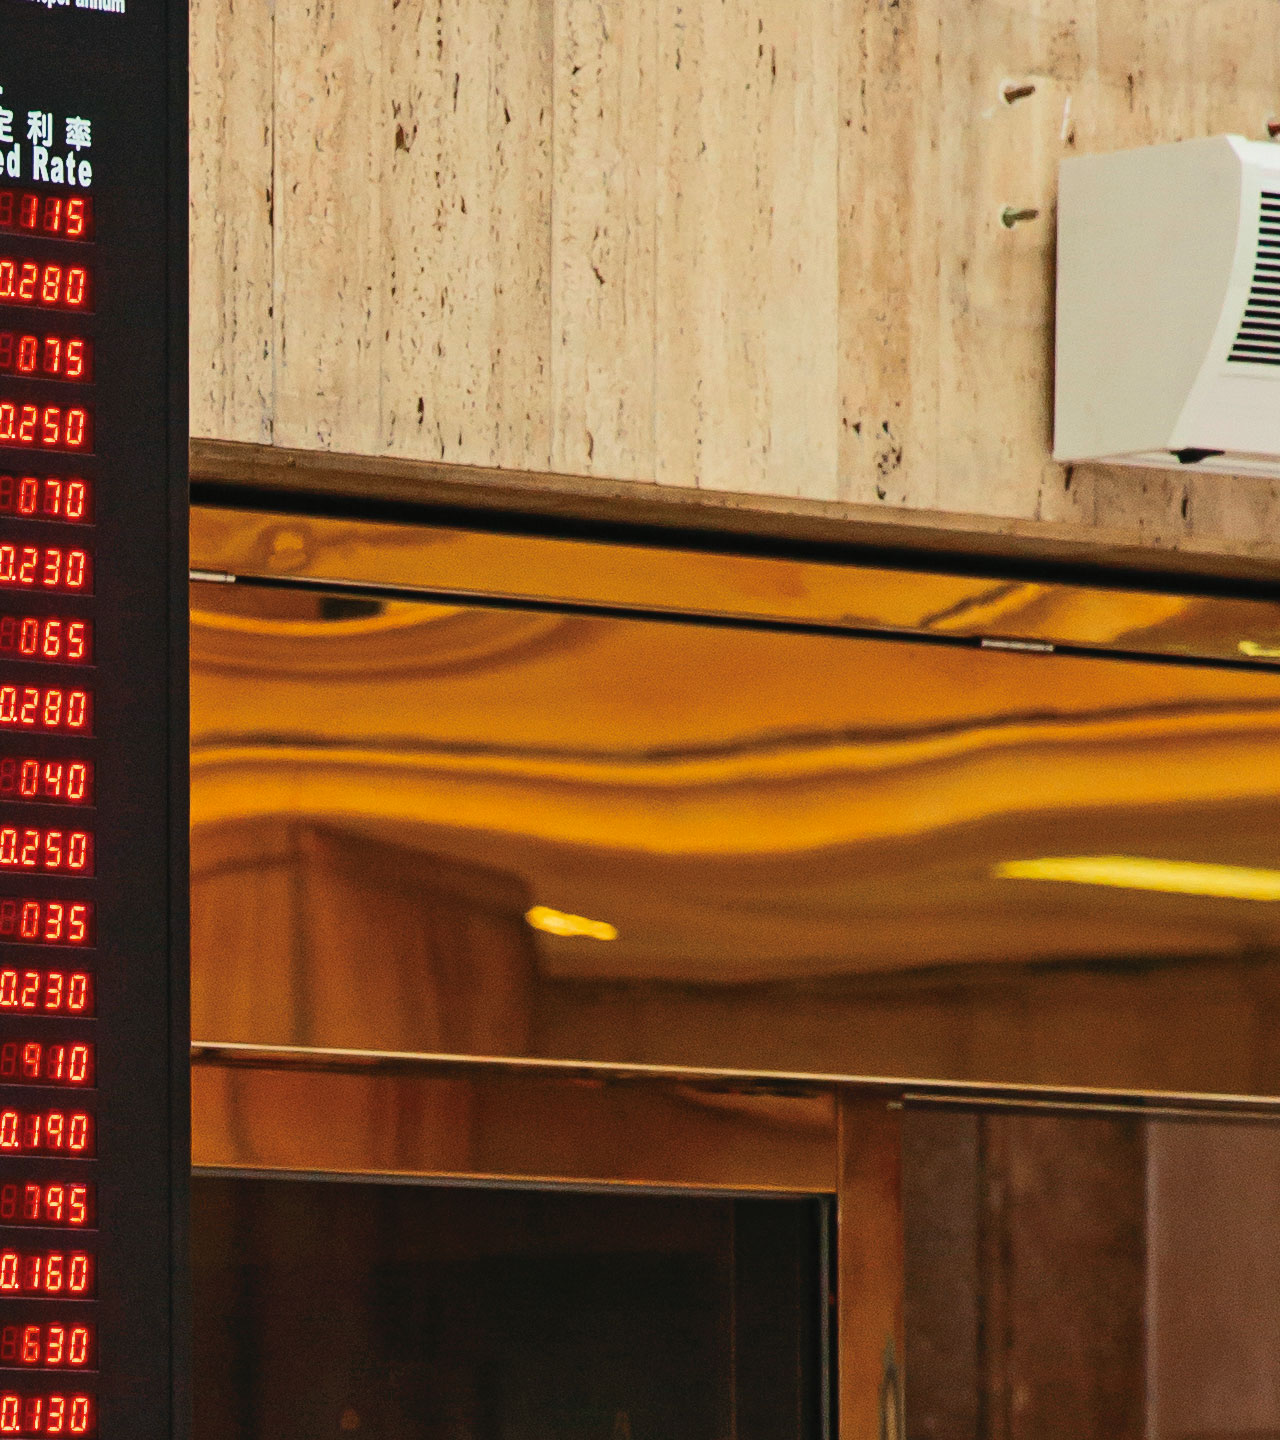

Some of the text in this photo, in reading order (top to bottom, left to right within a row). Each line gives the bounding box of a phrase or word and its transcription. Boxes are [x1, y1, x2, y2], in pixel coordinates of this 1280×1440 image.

[33, 142, 92, 187] Rate
[31, 198, 83, 234] 115
[20, 338, 83, 375] 075
[0, 1113, 87, 1149] 0.190
